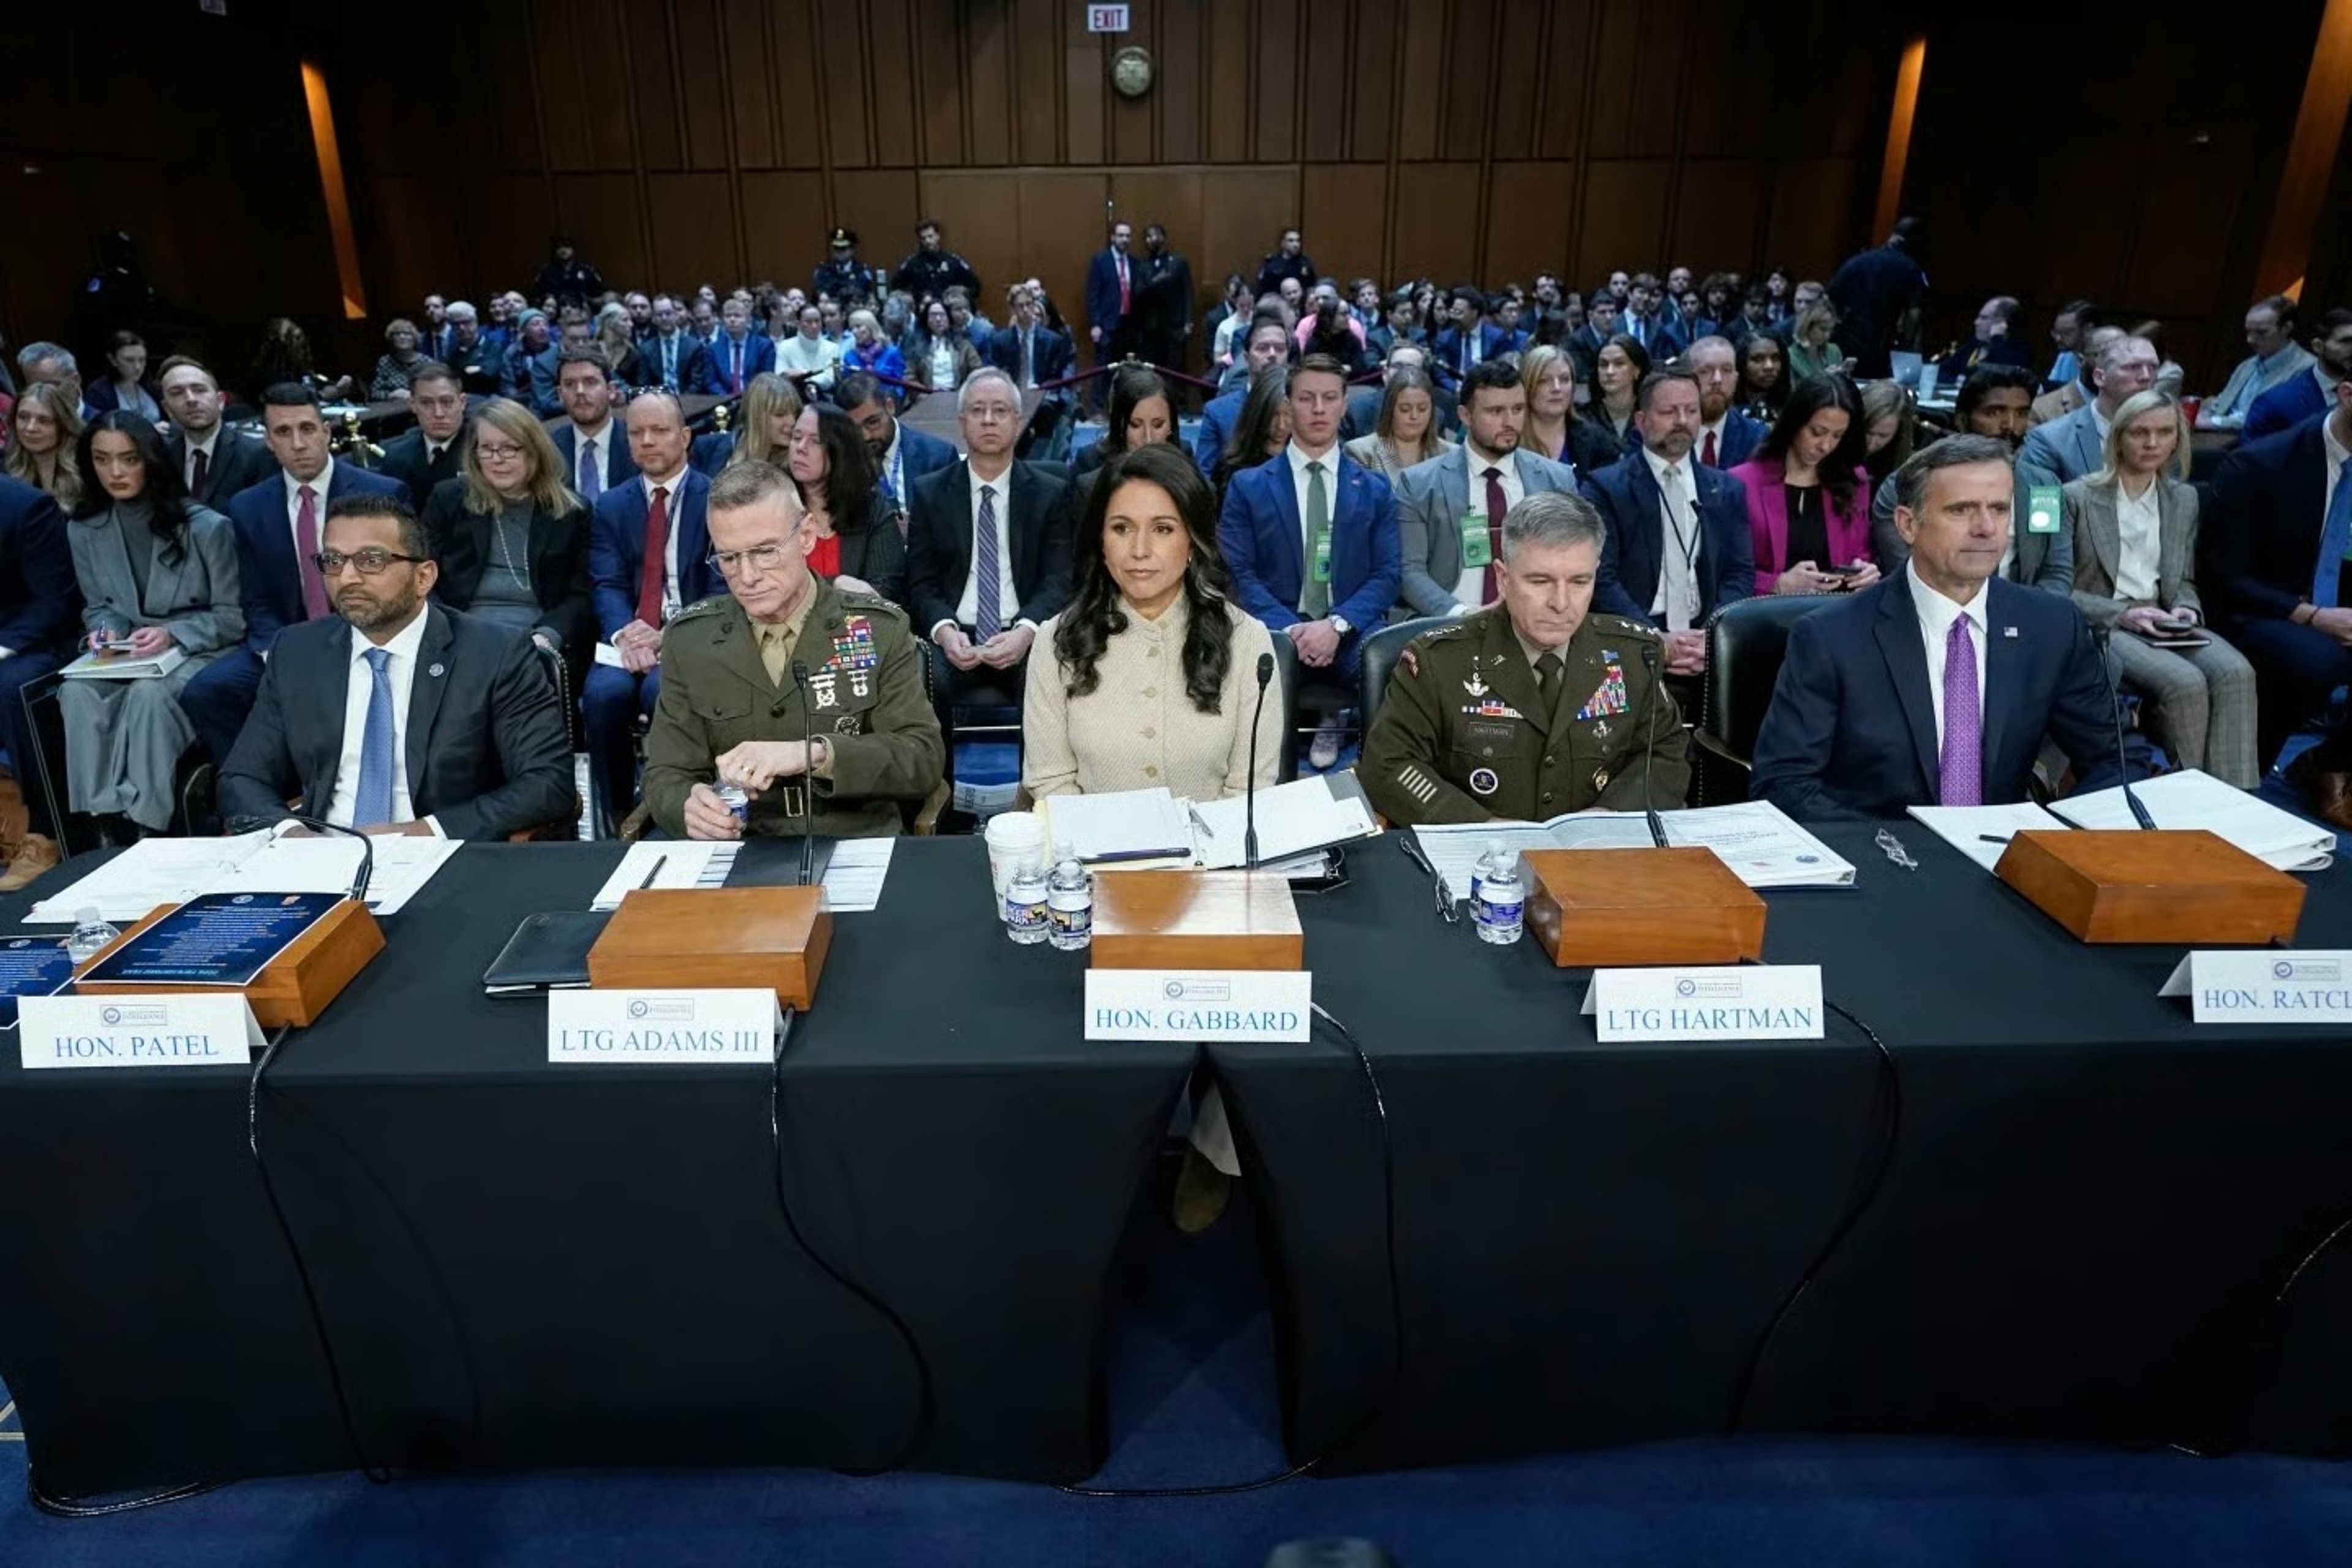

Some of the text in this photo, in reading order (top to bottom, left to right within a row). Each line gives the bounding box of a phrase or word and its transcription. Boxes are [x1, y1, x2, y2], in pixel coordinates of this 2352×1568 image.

[1094, 9, 1123, 28] EXIT
[2205, 989, 2265, 1008] HON.
[1096, 1009, 1298, 1031] HON. GABBARD
[1608, 1008, 1811, 1030] LTG HARTMAN
[55, 1035, 219, 1057] HON. PATEL
[562, 1030, 759, 1051] LTG ADAMS III
